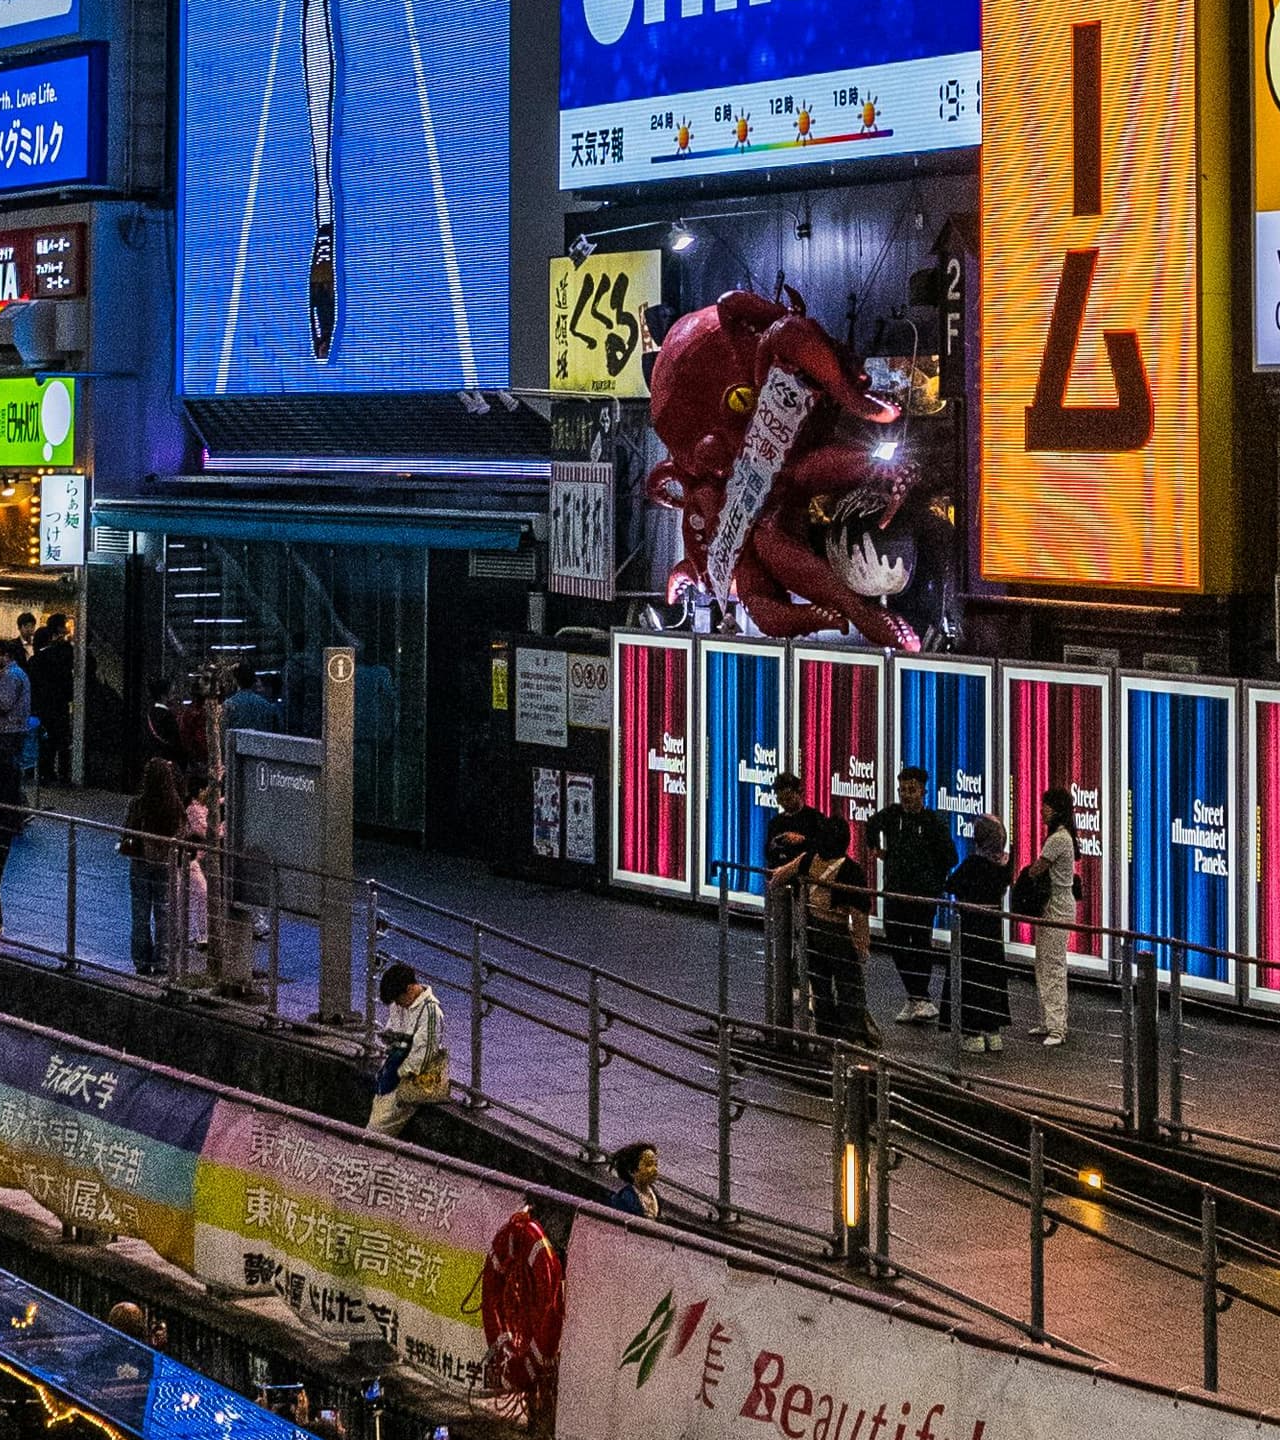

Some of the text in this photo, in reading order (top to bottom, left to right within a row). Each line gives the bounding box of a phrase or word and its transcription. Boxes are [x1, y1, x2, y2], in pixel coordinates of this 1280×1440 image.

[16, 87, 37, 109] Love
[38, 82, 58, 104] Life.
[768, 94, 794, 115] 12時
[832, 86, 859, 107] 18時
[649, 111, 674, 130] 24時
[570, 127, 624, 168] 天気予報
[946, 259, 962, 356] 2F
[46, 511, 62, 561] つけ麺
[663, 732, 685, 754] Street
[754, 742, 776, 765] Street
[849, 755, 874, 778] Street
[663, 773, 687, 795] Panels.
[956, 769, 982, 791] Street
[755, 785, 781, 808] Panels.
[1193, 797, 1224, 828] Street
[1193, 848, 1229, 877] Panels.
